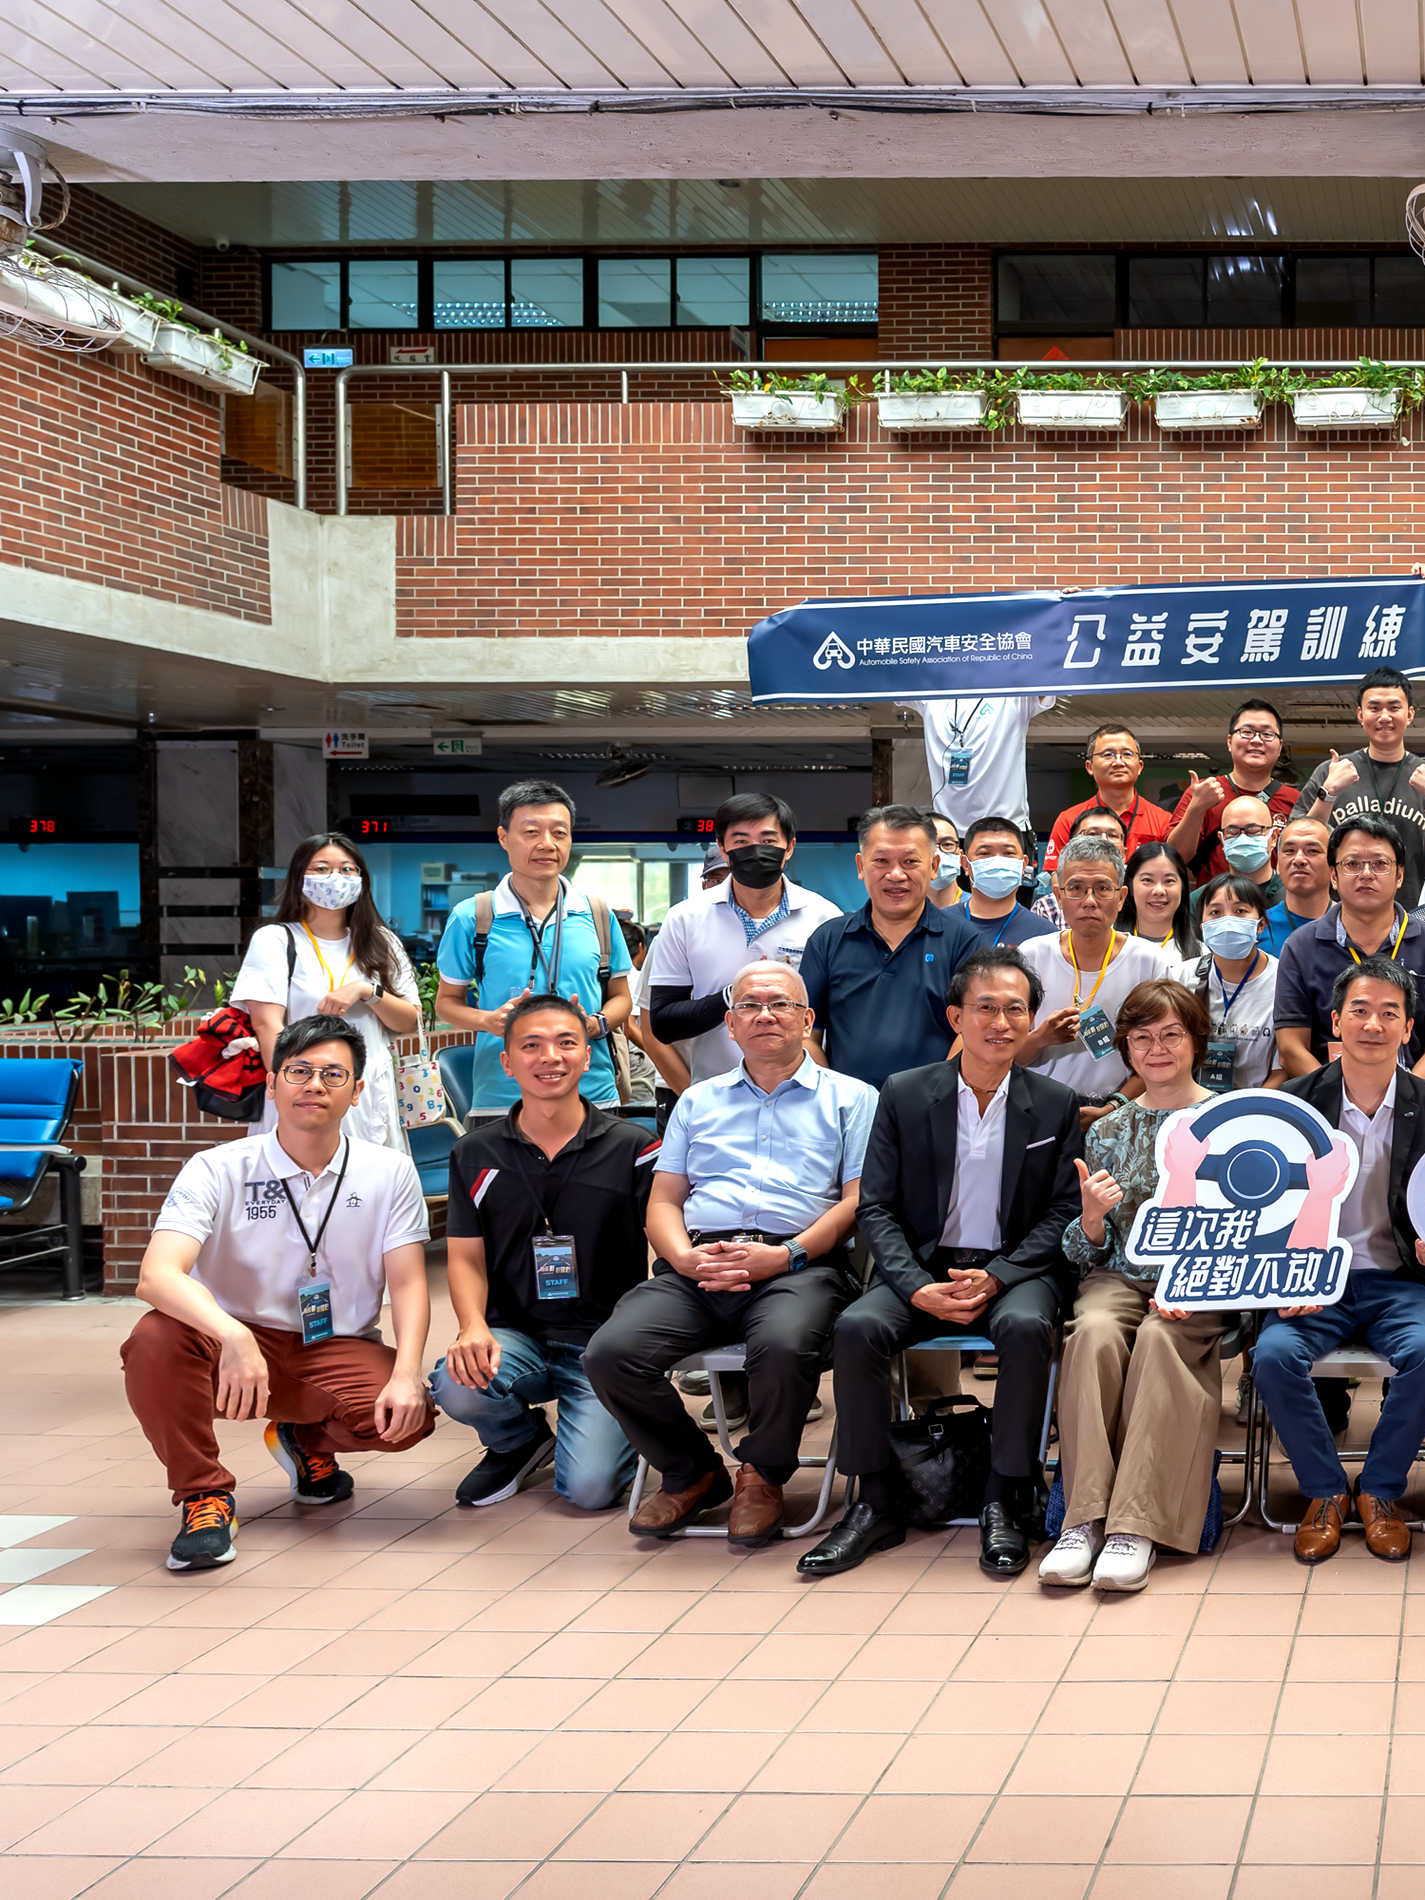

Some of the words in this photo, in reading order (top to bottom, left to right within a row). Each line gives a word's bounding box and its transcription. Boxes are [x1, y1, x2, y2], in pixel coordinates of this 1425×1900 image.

[1063, 604, 1405, 669] 公益安駕訓練
[856, 631, 1032, 656] 中華民國汽車安全協會
[859, 657, 898, 665] Automobile
[899, 656, 920, 665] Safety
[922, 654, 960, 664] Association
[970, 653, 1001, 662] Republic
[1011, 652, 1033, 660] China
[30, 820, 55, 832] 378
[361, 820, 388, 832] 371
[697, 819, 714, 832] 38
[245, 1205, 277, 1220] 1955
[1140, 1209, 1257, 1251] 這次我
[1170, 1250, 1340, 1298] 絕對不放!
[545, 1279, 569, 1288] STAFF
[309, 1317, 329, 1328] STAFF
